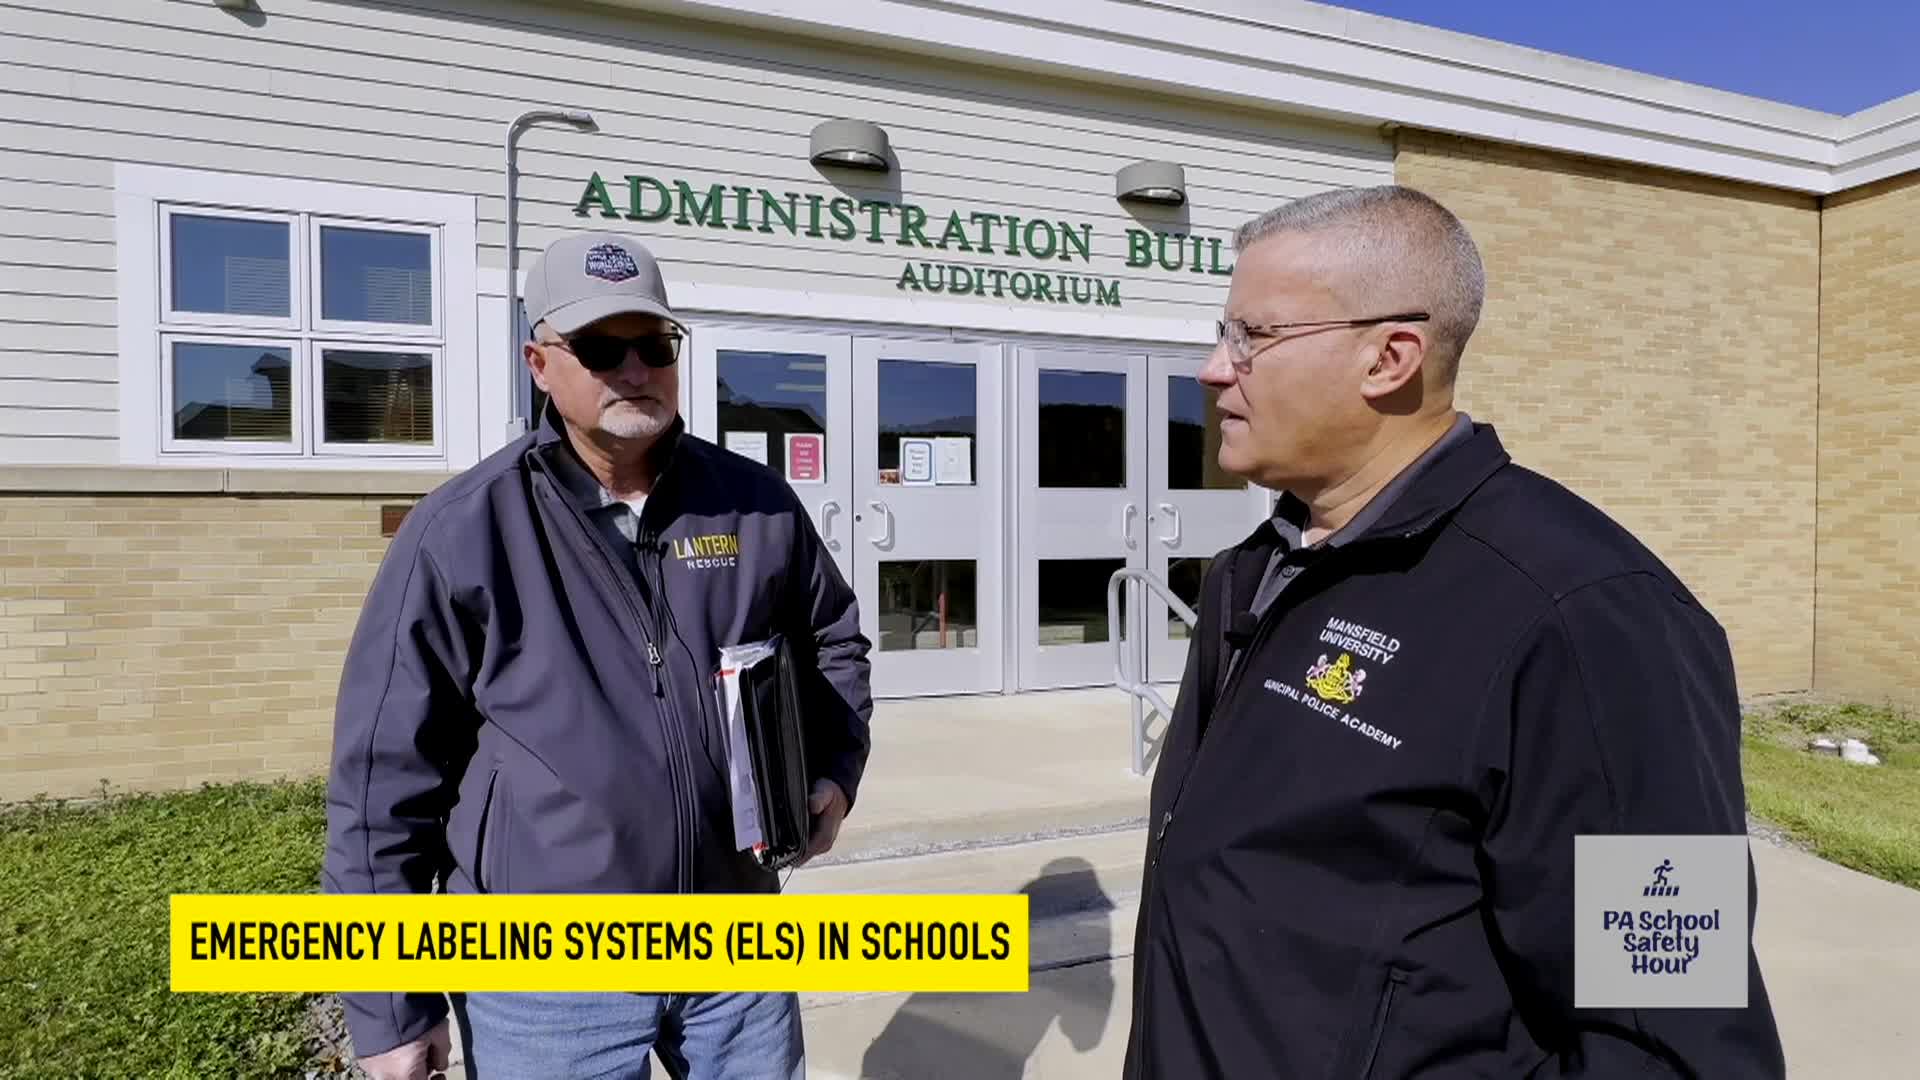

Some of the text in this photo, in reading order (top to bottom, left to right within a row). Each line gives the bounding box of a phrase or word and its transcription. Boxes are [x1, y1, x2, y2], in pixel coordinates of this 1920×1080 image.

[572, 171, 1093, 264] ADMINISTRATION
[897, 262, 1122, 307] AUDITORIUM
[673, 534, 739, 560] LANTERN
[687, 557, 736, 570] RESCUE
[1319, 629, 1394, 665] UNIVERSITY
[1326, 617, 1401, 653] MANSFIELD
[1301, 693, 1341, 720] POLICE
[1340, 713, 1402, 750] ACADEMY
